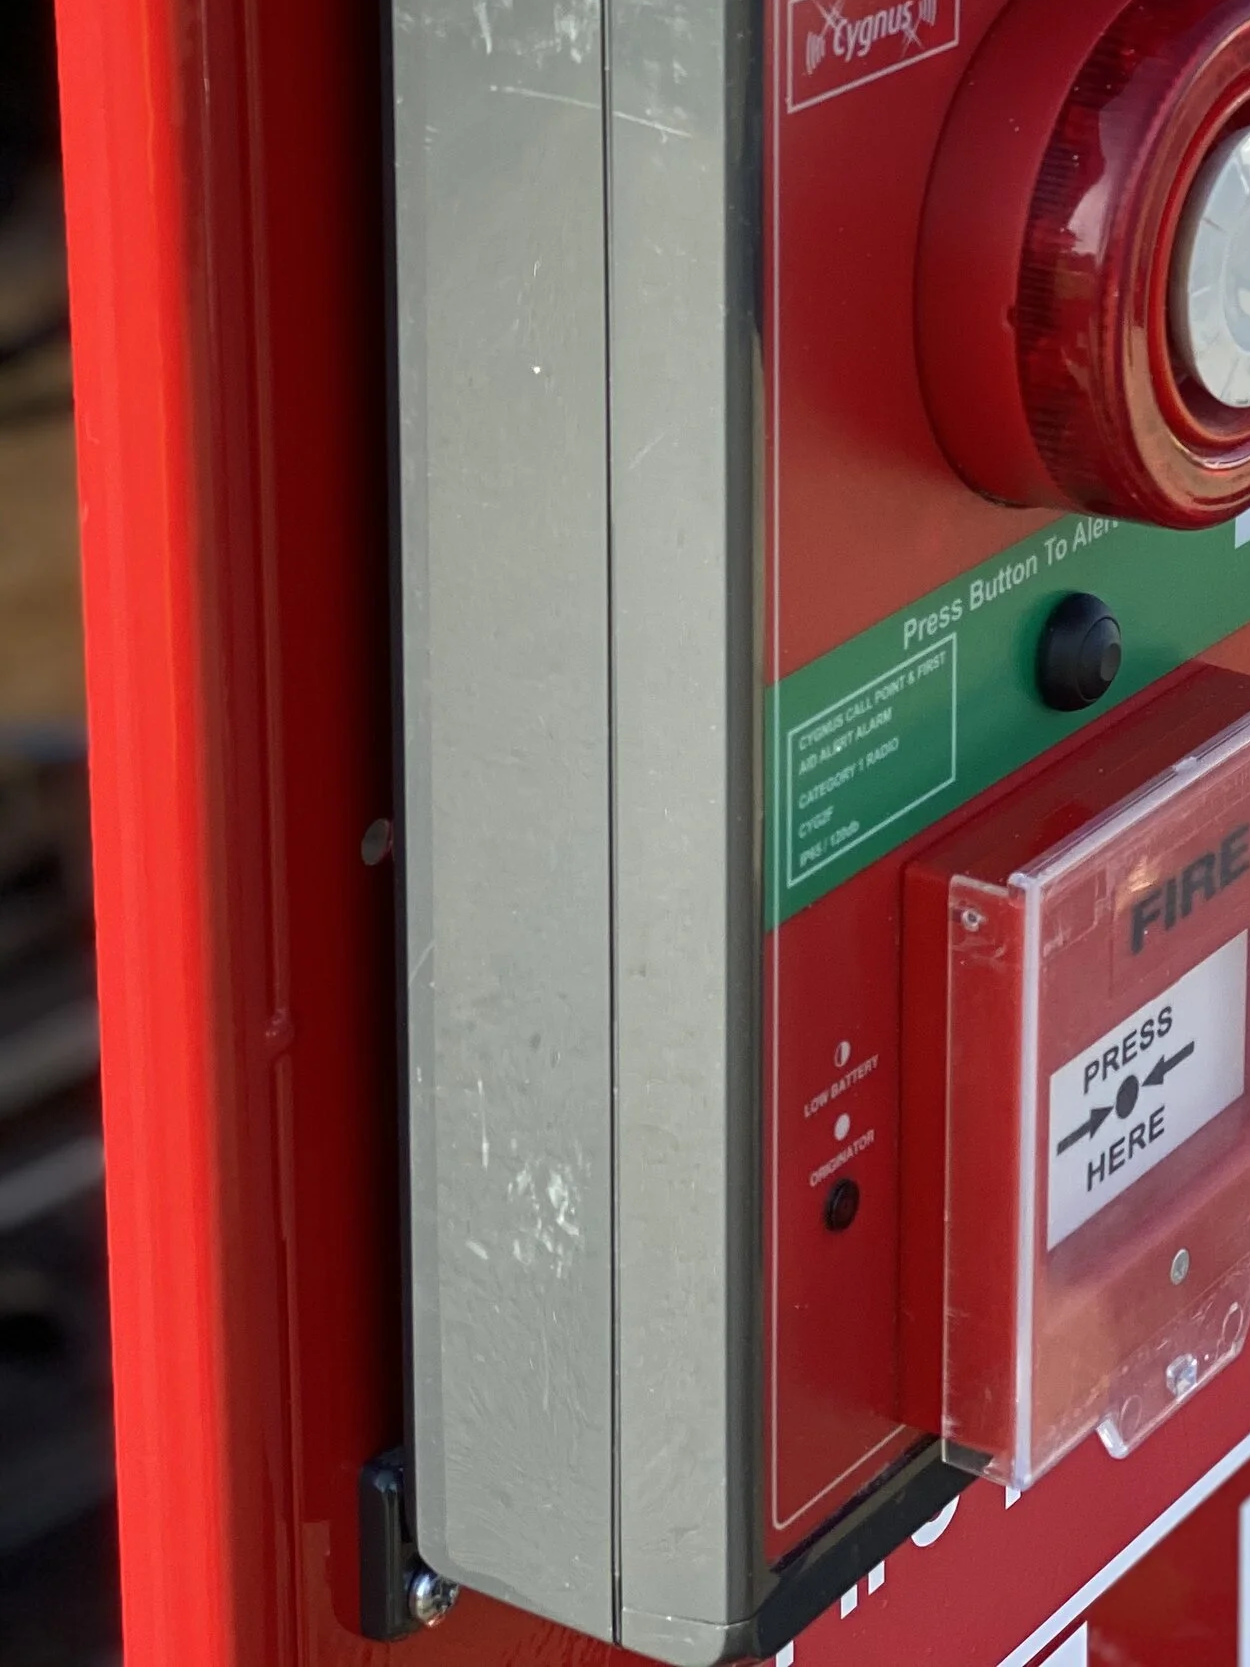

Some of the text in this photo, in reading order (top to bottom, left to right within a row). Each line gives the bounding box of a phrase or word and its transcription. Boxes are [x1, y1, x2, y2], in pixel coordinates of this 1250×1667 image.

[903, 597, 963, 650] Press
[969, 554, 1038, 611] Button
[1044, 535, 1068, 566] To
[845, 697, 873, 722] CALL
[917, 650, 947, 679] FIRST
[854, 706, 893, 742] ALARM
[1128, 821, 1250, 957] FIRE
[804, 1053, 879, 1119] LOW BATTERY
[1082, 1004, 1173, 1095] PRESS
[809, 1128, 875, 1188] ORIGINATOR
[1085, 1105, 1166, 1193] HERE
